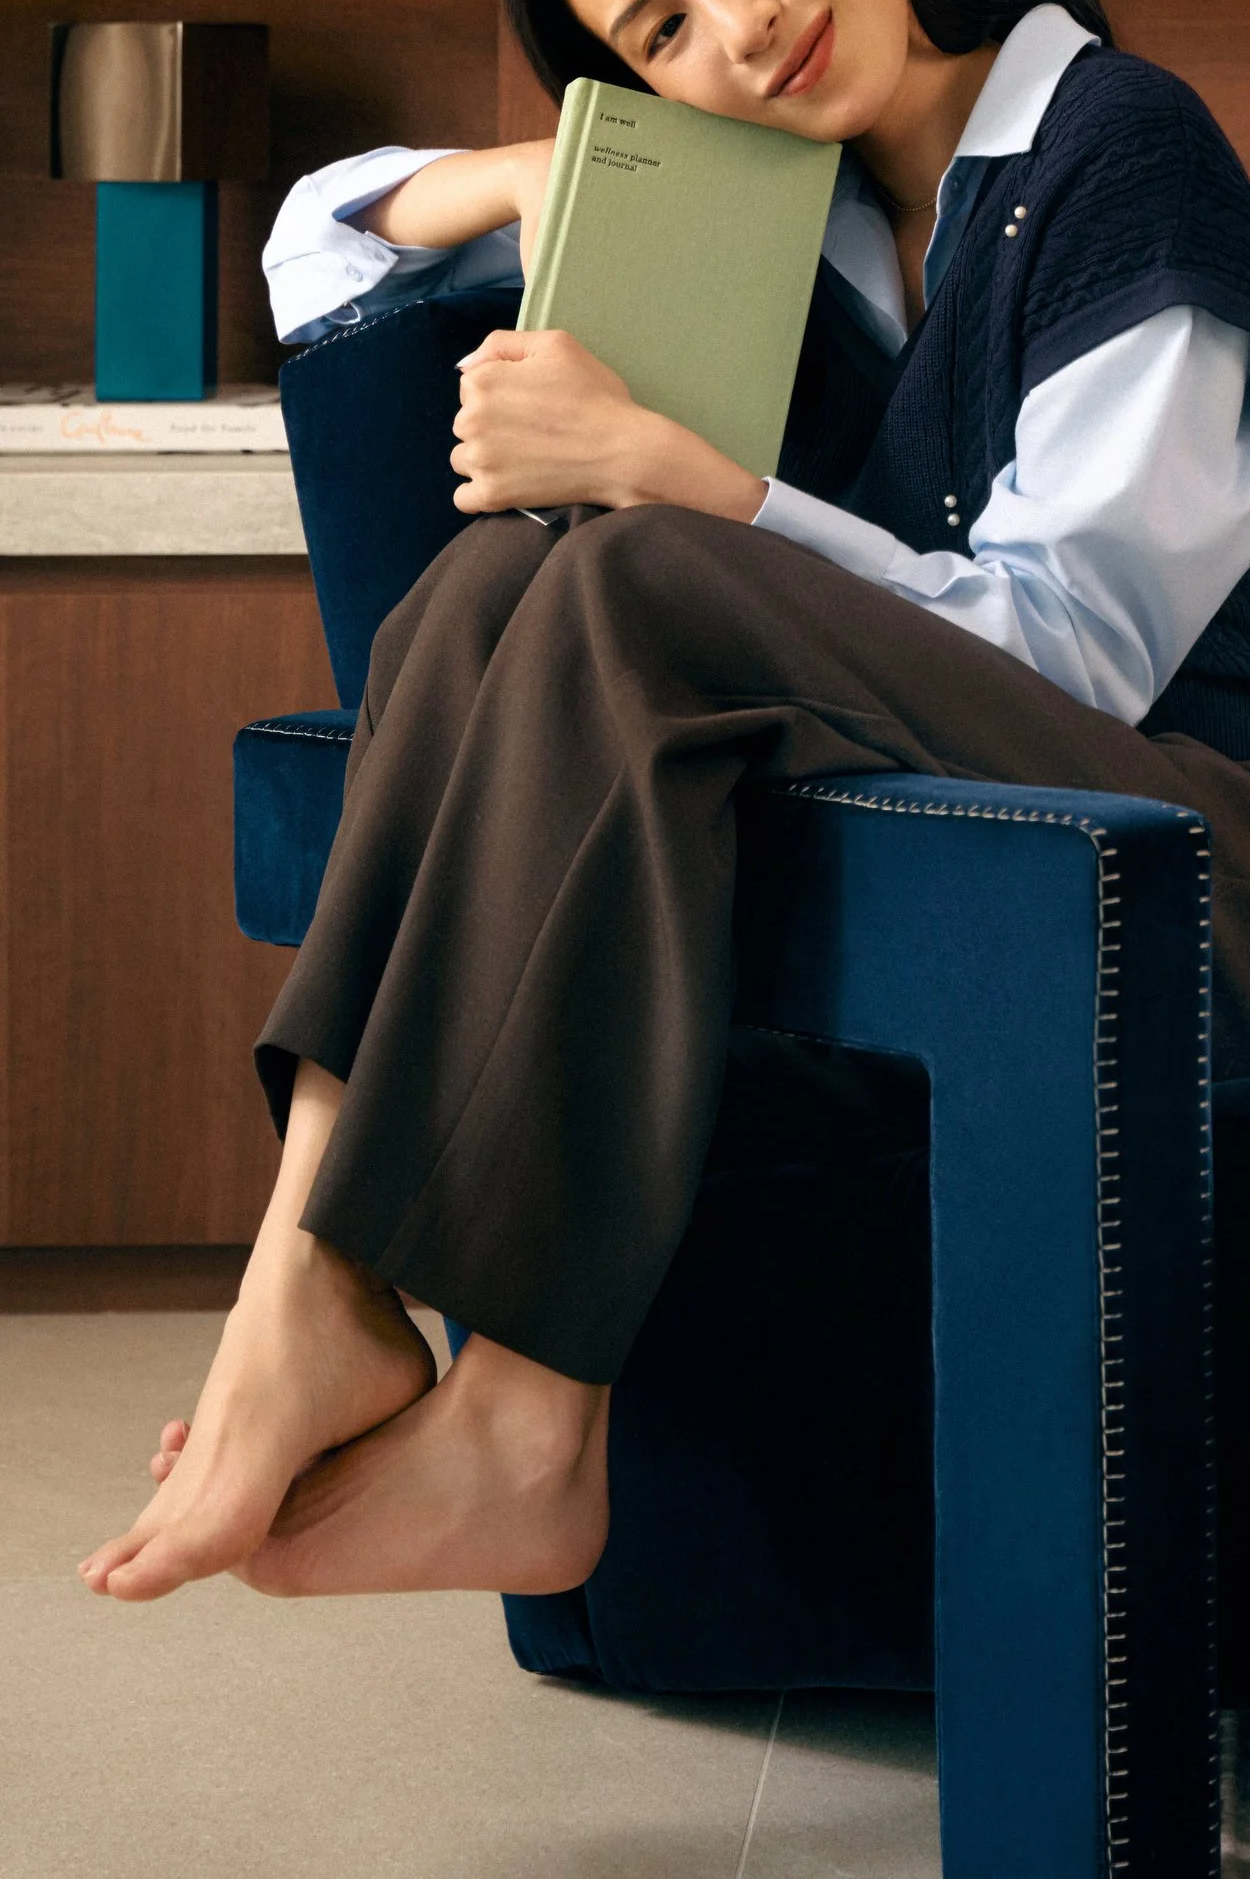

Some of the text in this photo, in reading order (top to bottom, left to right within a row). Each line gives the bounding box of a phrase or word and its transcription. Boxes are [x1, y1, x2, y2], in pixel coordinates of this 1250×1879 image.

[620, 119, 636, 128] well
[591, 156, 637, 171] and journal
[594, 146, 661, 167] wellness planner
